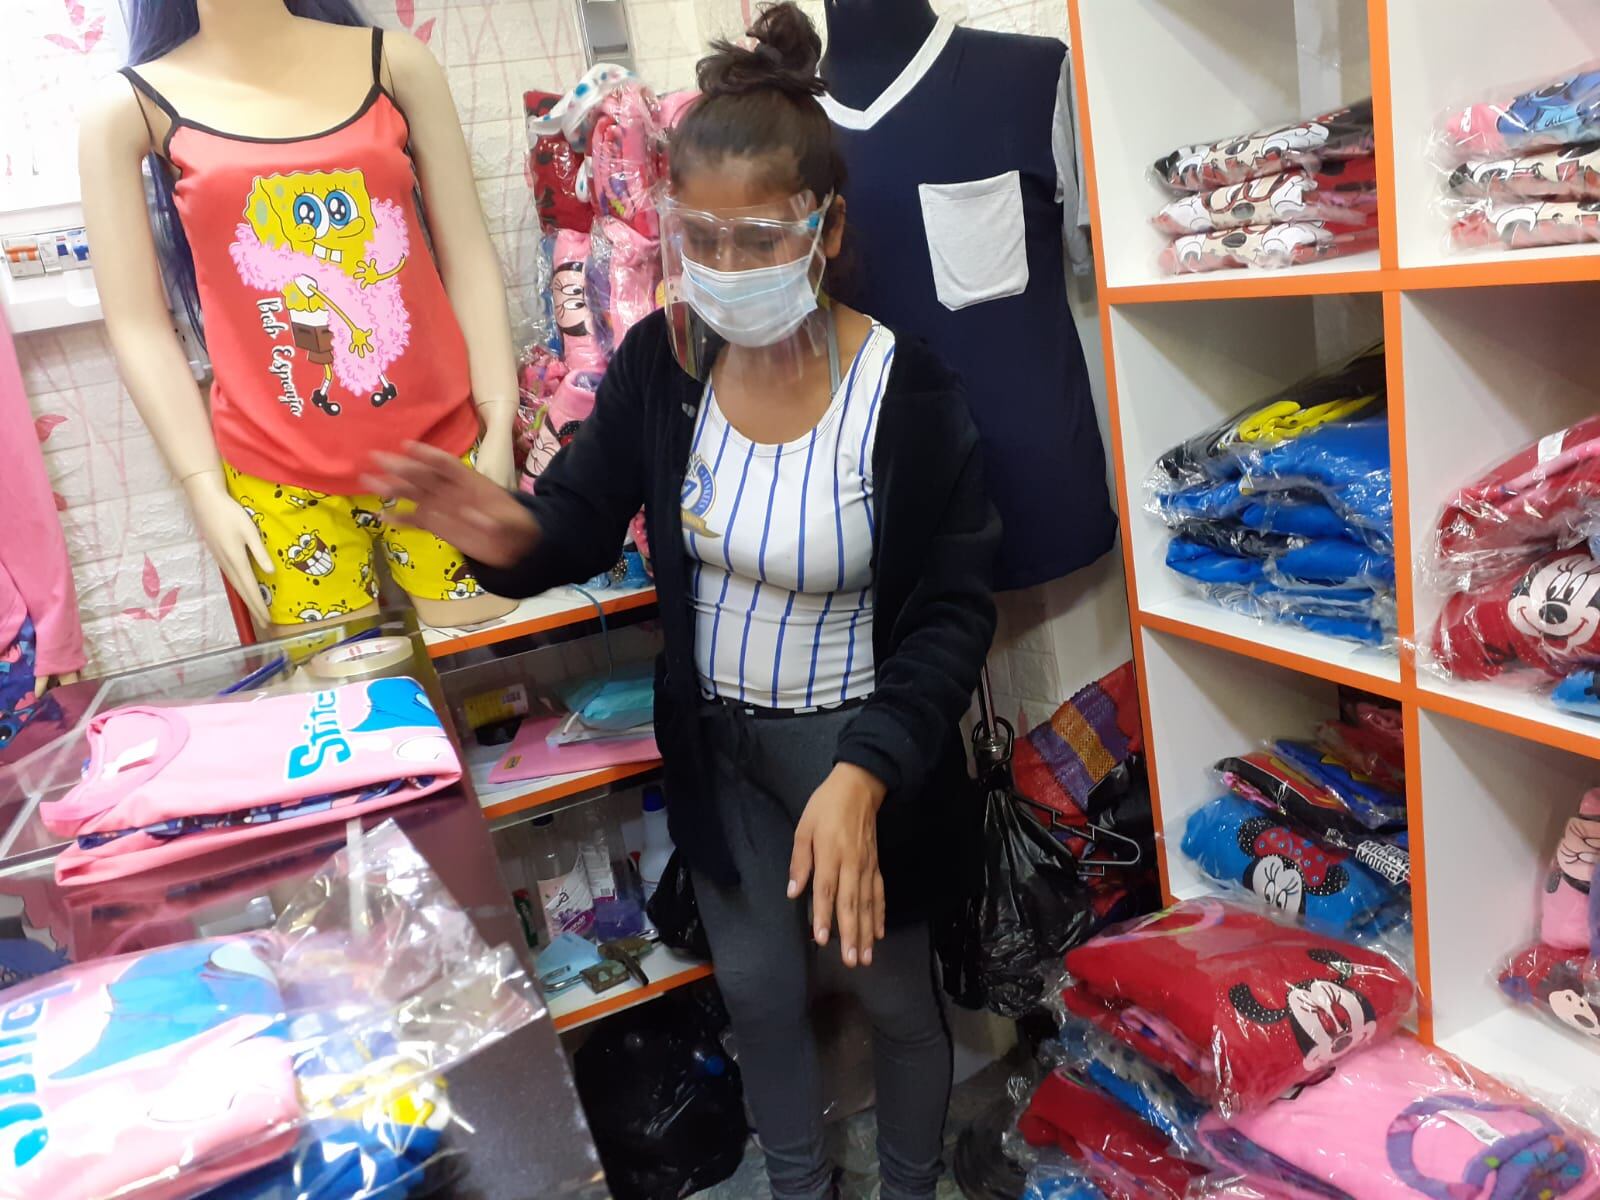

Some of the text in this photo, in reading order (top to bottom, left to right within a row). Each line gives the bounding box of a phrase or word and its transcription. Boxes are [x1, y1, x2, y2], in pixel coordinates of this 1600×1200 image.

[257, 298, 288, 339] Bob
[1356, 848, 1399, 881] MOUSE
[1360, 840, 1405, 869] MICKEY
